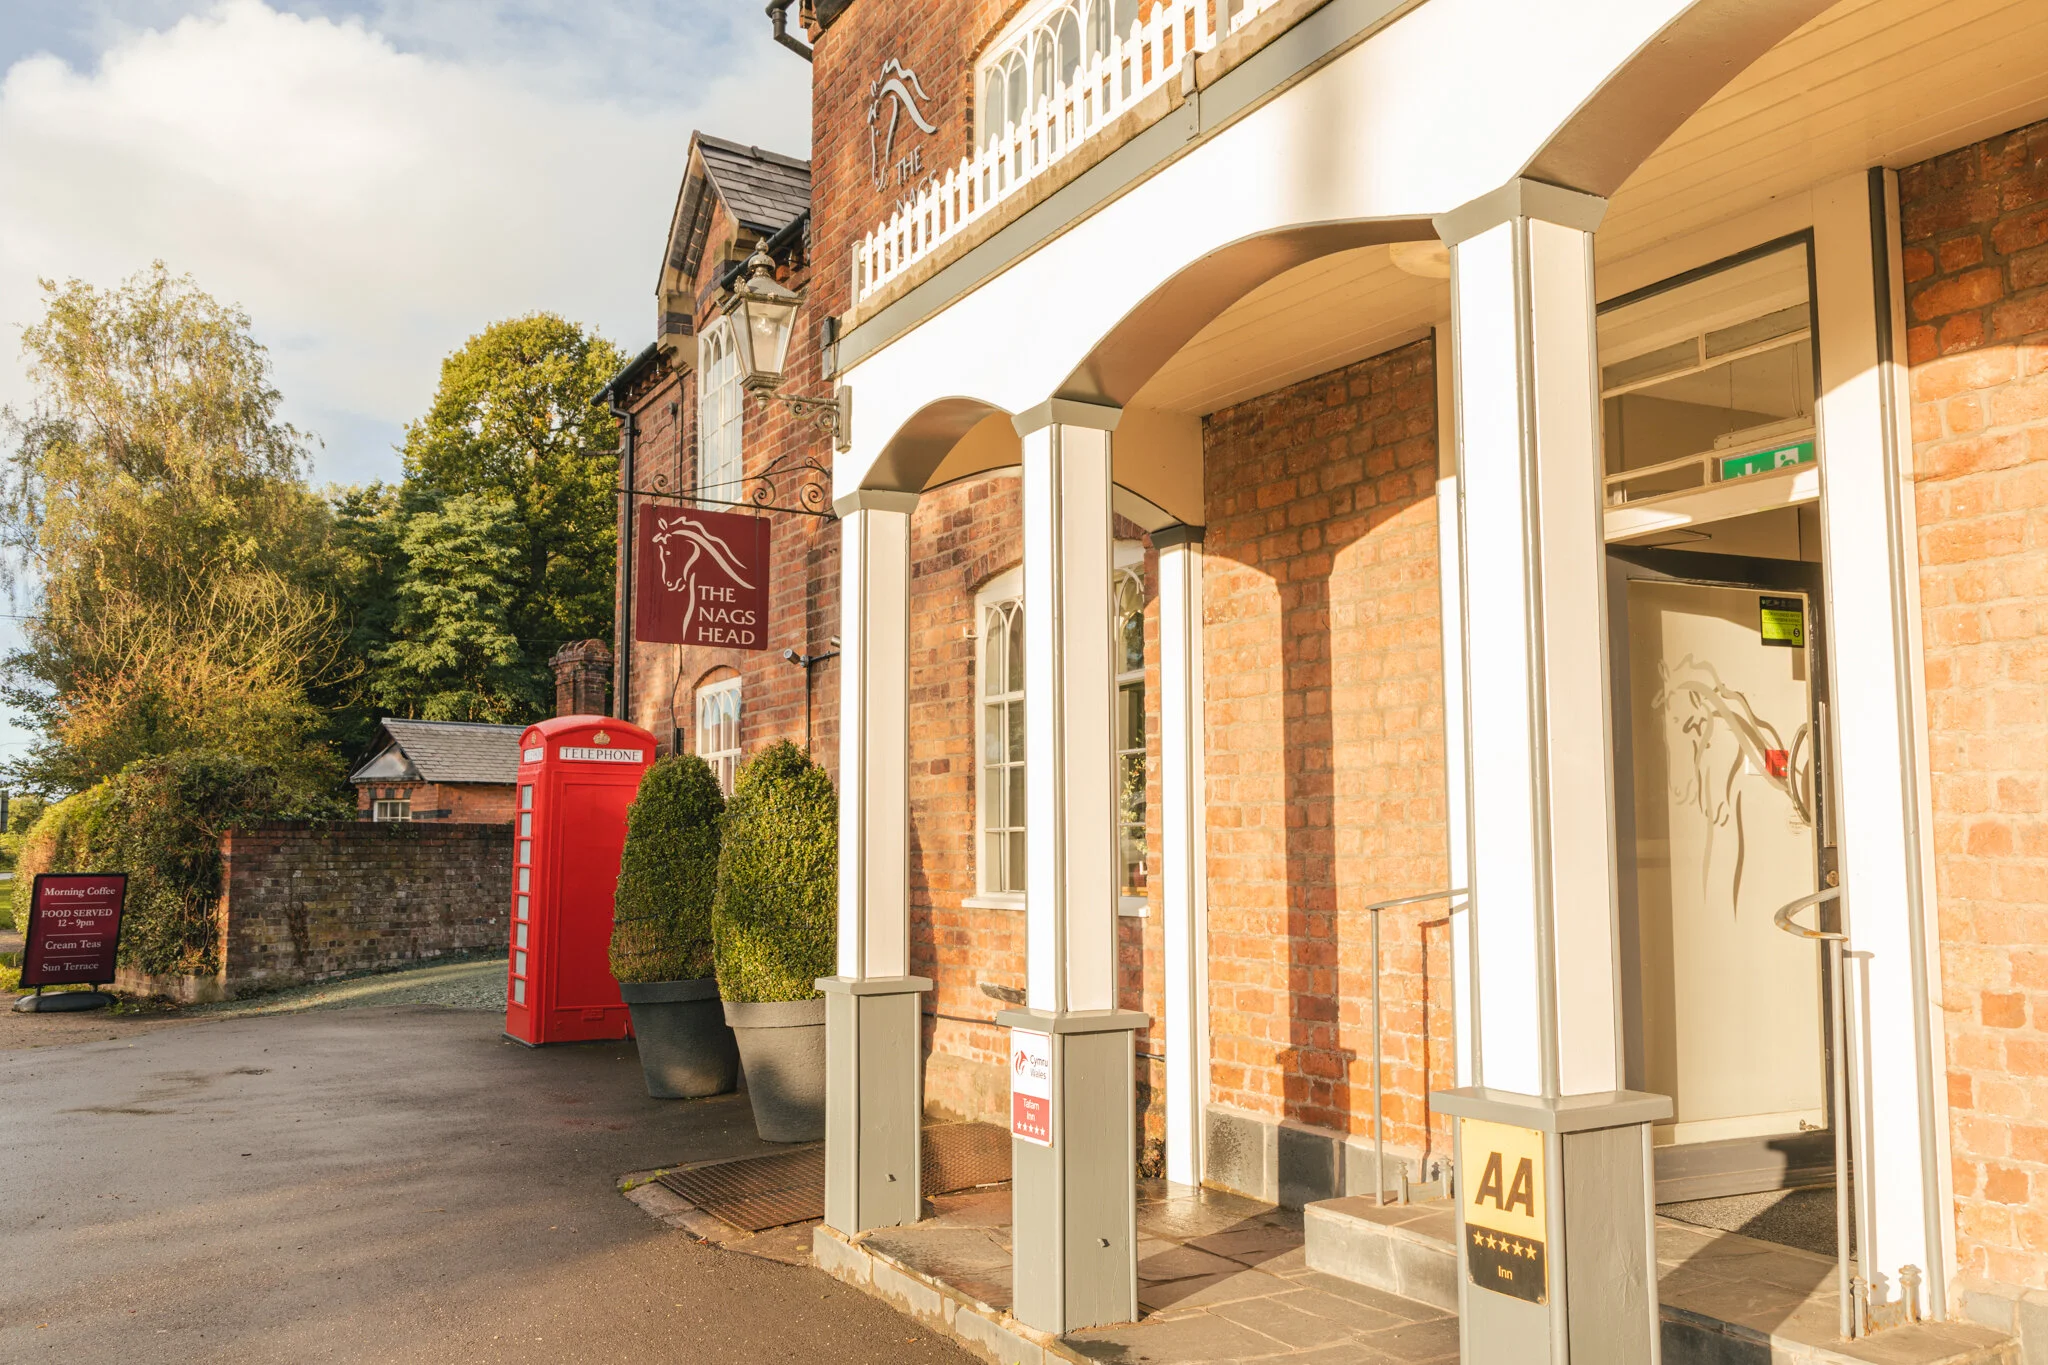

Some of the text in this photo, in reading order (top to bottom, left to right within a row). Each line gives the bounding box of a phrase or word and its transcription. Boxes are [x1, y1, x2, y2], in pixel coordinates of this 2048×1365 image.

[896, 144, 922, 185] THE
[698, 585, 736, 603] THE
[699, 606, 756, 626] NAGS
[698, 626, 755, 645] HEAD
[564, 747, 639, 761] TELEPHONE
[44, 886, 116, 898] Morning Coffee
[41, 908, 113, 918] FOOD SERVED
[58, 919, 67, 927] 12
[75, 918, 95, 928] 9pm
[45, 939, 102, 950] Cream Teas
[42, 962, 99, 972] Sun Terrace
[1030, 1054, 1048, 1068] Cymru
[1030, 1068, 1047, 1080] Wales
[1026, 1111, 1036, 1121] Inn
[1475, 1151, 1534, 1217] AA
[1498, 1265, 1513, 1281] Inn
